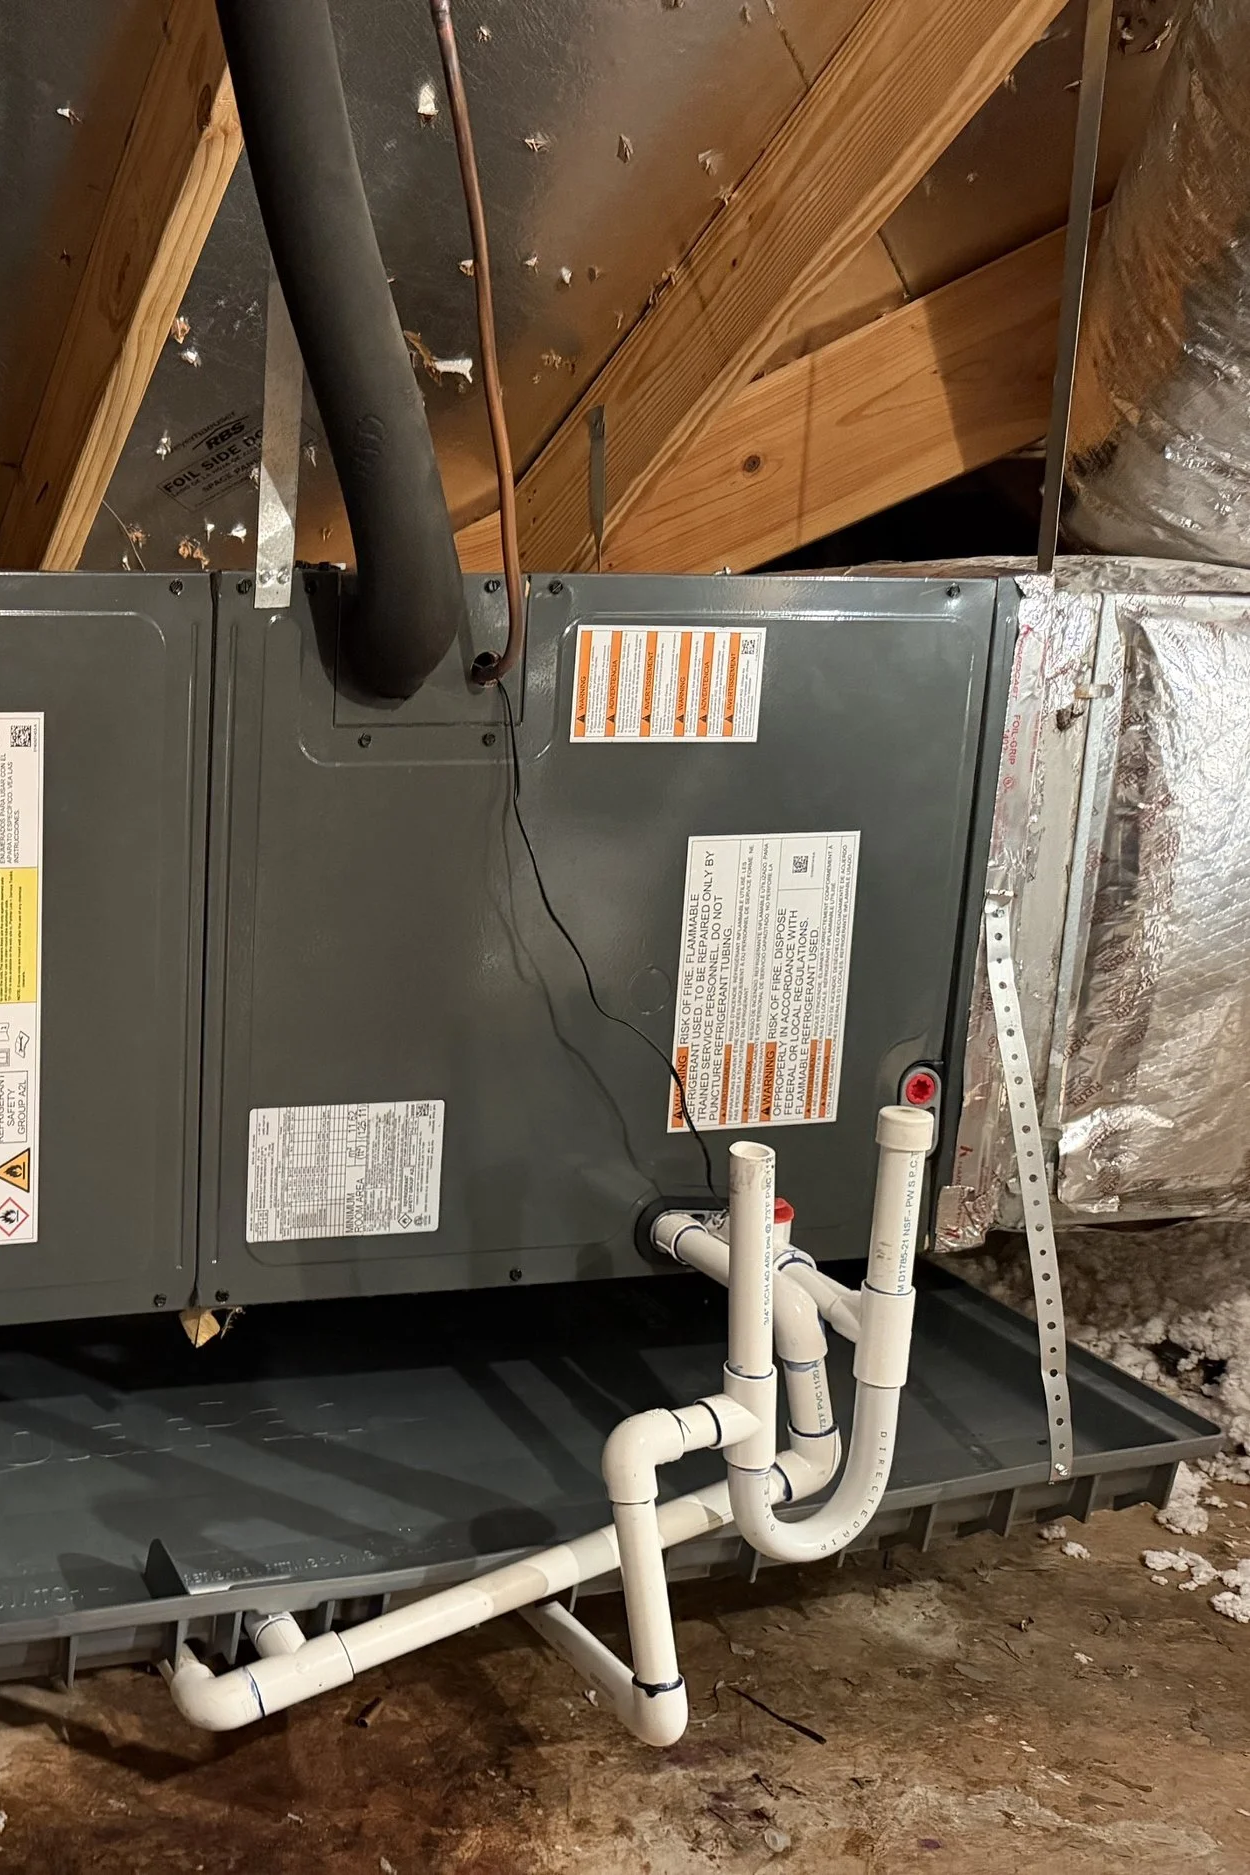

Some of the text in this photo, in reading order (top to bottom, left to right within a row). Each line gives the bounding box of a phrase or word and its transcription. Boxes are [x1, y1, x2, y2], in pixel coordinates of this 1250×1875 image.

[206, 420, 245, 451] RBS
[163, 445, 241, 494] FOIL SIDE
[578, 676, 586, 711] WARNING
[609, 660, 617, 709] ADVERTENCIA
[644, 652, 653, 710] AVERTISSEMENT
[678, 677, 686, 710] WARNING
[701, 661, 709, 710] ADVERTENCIA
[726, 653, 736, 710] AVERTISSEMENT
[1010, 715, 1021, 765] FOIL-GRIP
[705, 851, 714, 866] BY
[702, 870, 712, 901] ONLY
[686, 894, 699, 963] FLAMMABLE
[698, 904, 710, 963] REPAIRED
[683, 968, 693, 996] FIRE.
[695, 985, 703, 1000] TO
[696, 968, 705, 981] BE
[682, 1000, 690, 1015] OF
[690, 1005, 702, 1038] USED.
[698, 895, 722, 1122] TRAINED SERVICE PERSONNEL. DO NOT
[709, 925, 732, 1120] PUNCTURE REFRIGERANT TUBING.
[762, 908, 786, 1106] WARNING RISK OF FIRE. DISPOSE
[773, 910, 798, 1116] OFPROPERLY IN ACCORDANCE WITH
[784, 918, 808, 1115] FEDERAL OR LOCAL REGULATIONS.
[795, 927, 819, 1115] FLAMMABLE REFRIGERANT USED.
[680, 1018, 689, 1044] RISK
[7, 1089, 15, 1126] SAFETY
[18, 1080, 26, 1134] GROUP A2L
[346, 1193, 355, 1233] MINIMUM
[355, 1179, 364, 1232] ROOM AREA
[764, 1270, 770, 1282] 40
[898, 1239, 909, 1281] D1785-21
[815, 1391, 823, 1410] PVC
